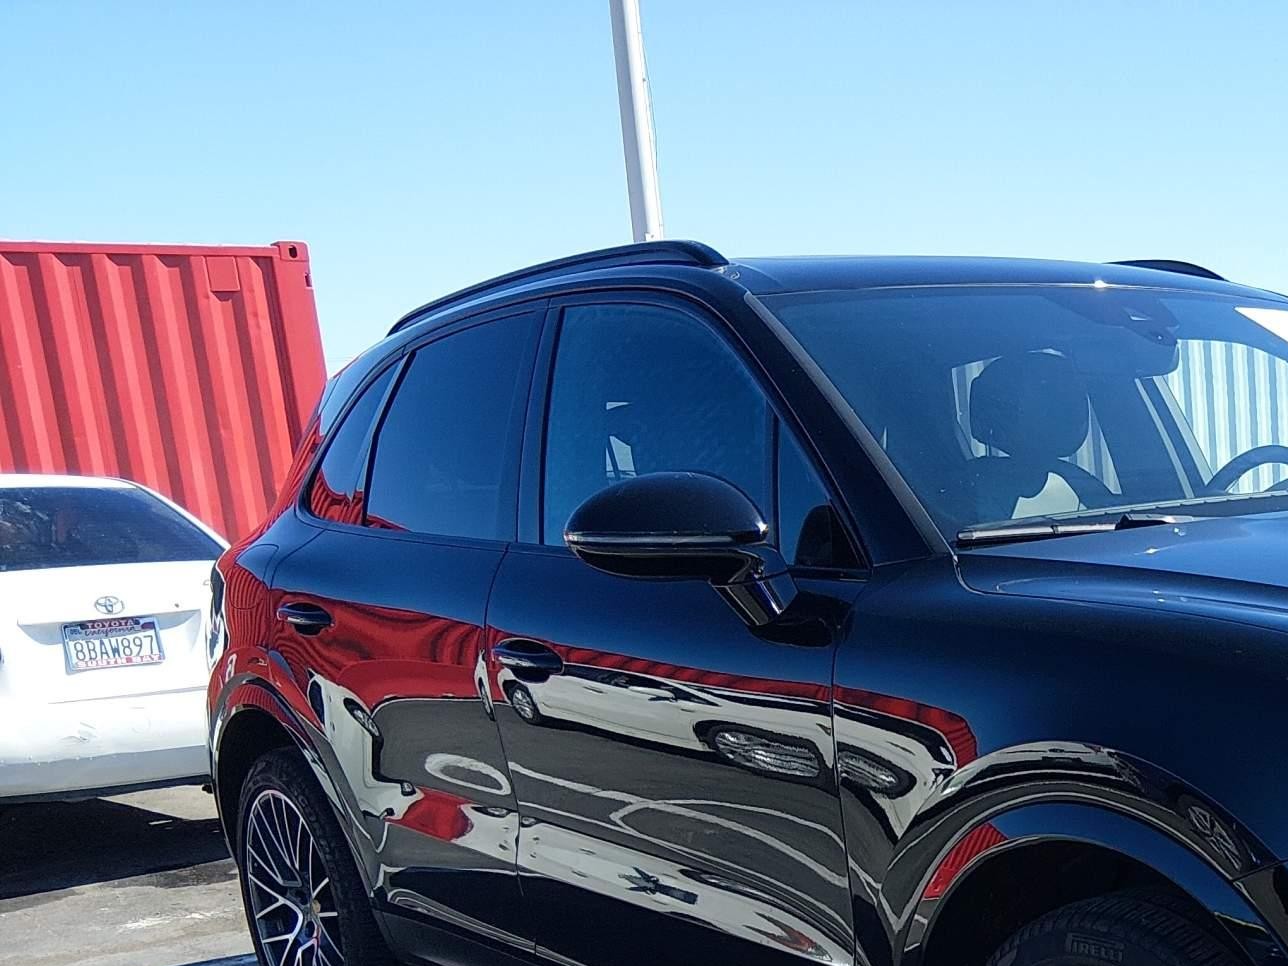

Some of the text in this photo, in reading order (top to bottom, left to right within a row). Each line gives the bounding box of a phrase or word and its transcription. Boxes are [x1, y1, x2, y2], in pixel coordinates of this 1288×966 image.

[87, 619, 134, 629] TOYOTA
[74, 635, 153, 661] 8BAW897
[76, 657, 127, 669] SOUTH
[1065, 932, 1125, 963] PIRELLI
